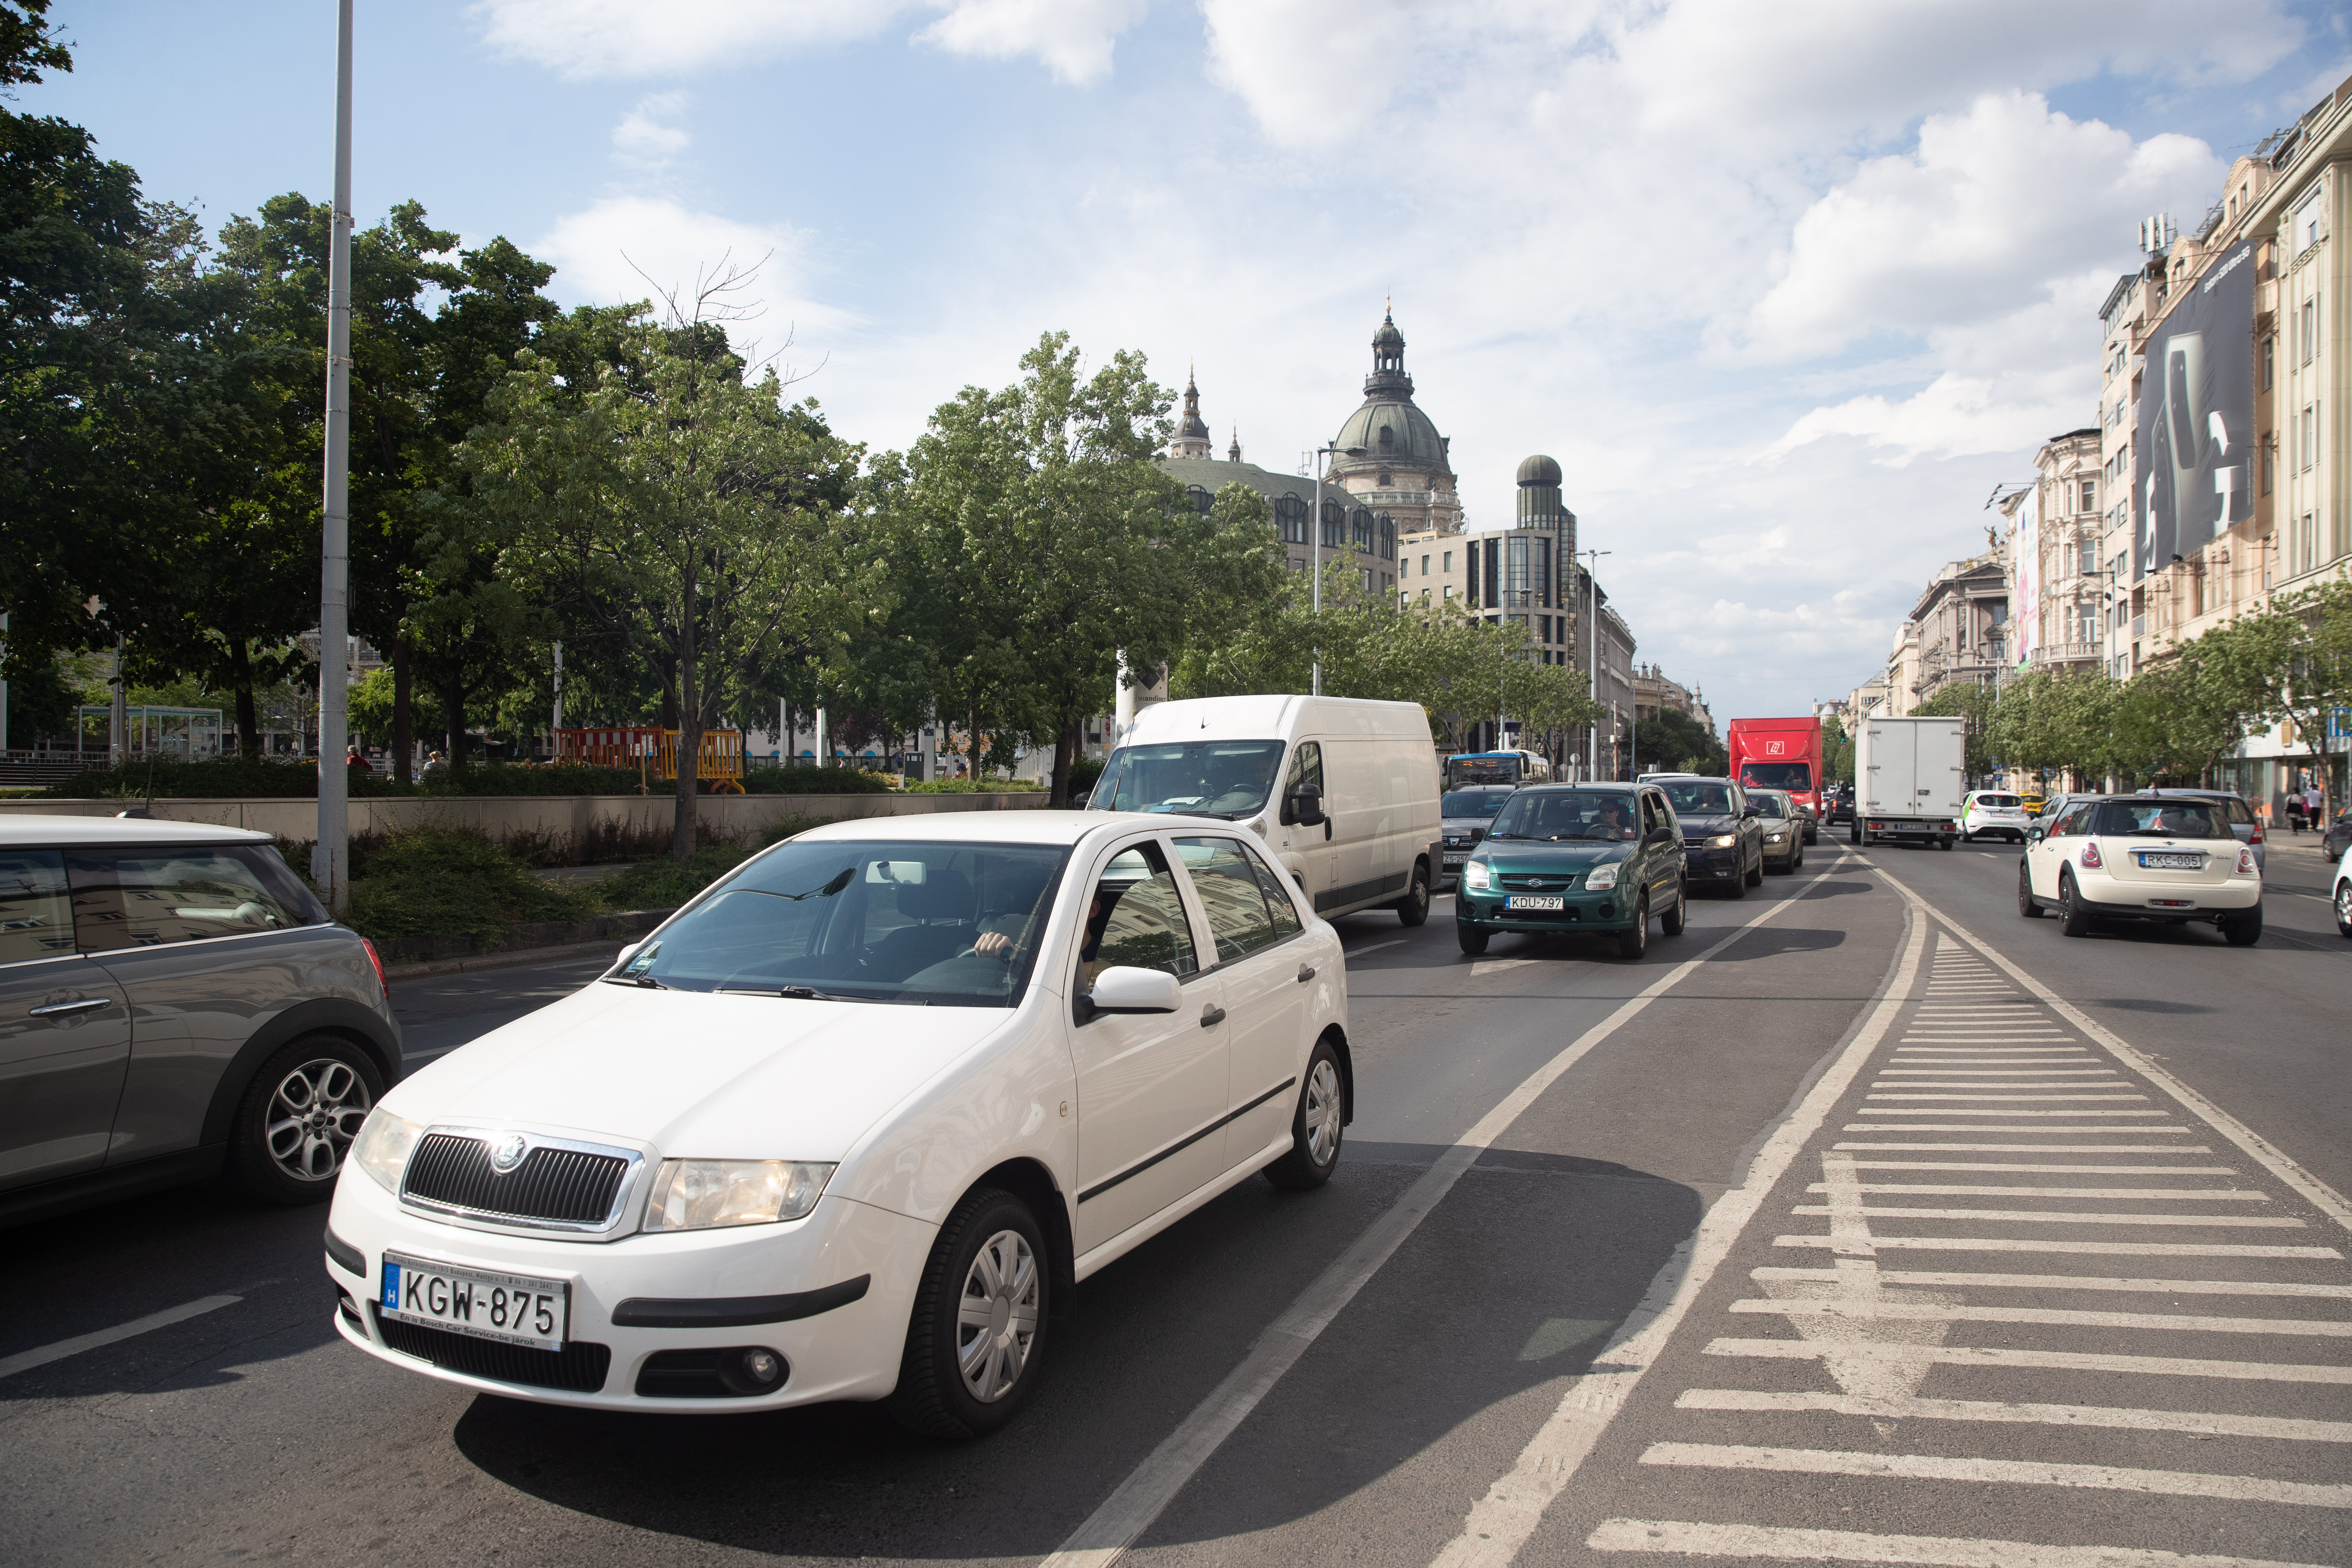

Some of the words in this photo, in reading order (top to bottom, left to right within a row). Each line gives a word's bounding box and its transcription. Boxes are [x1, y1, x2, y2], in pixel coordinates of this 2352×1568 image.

[2204, 273, 2219, 293] Galaxy
[2219, 263, 2229, 279] S20
[2227, 254, 2242, 271] Ultra
[2241, 245, 2251, 260] 5G
[2147, 855, 2198, 865] RKC-005
[1512, 897, 1561, 908] KDU-797
[450, 1268, 475, 1278] Budapest,
[387, 1289, 395, 1303] H
[406, 1270, 554, 1334] KGW-875
[420, 1318, 444, 1329] Bosch
[446, 1323, 462, 1332] Car
[464, 1327, 510, 1341] Service-be
[512, 1335, 536, 1346] járok
